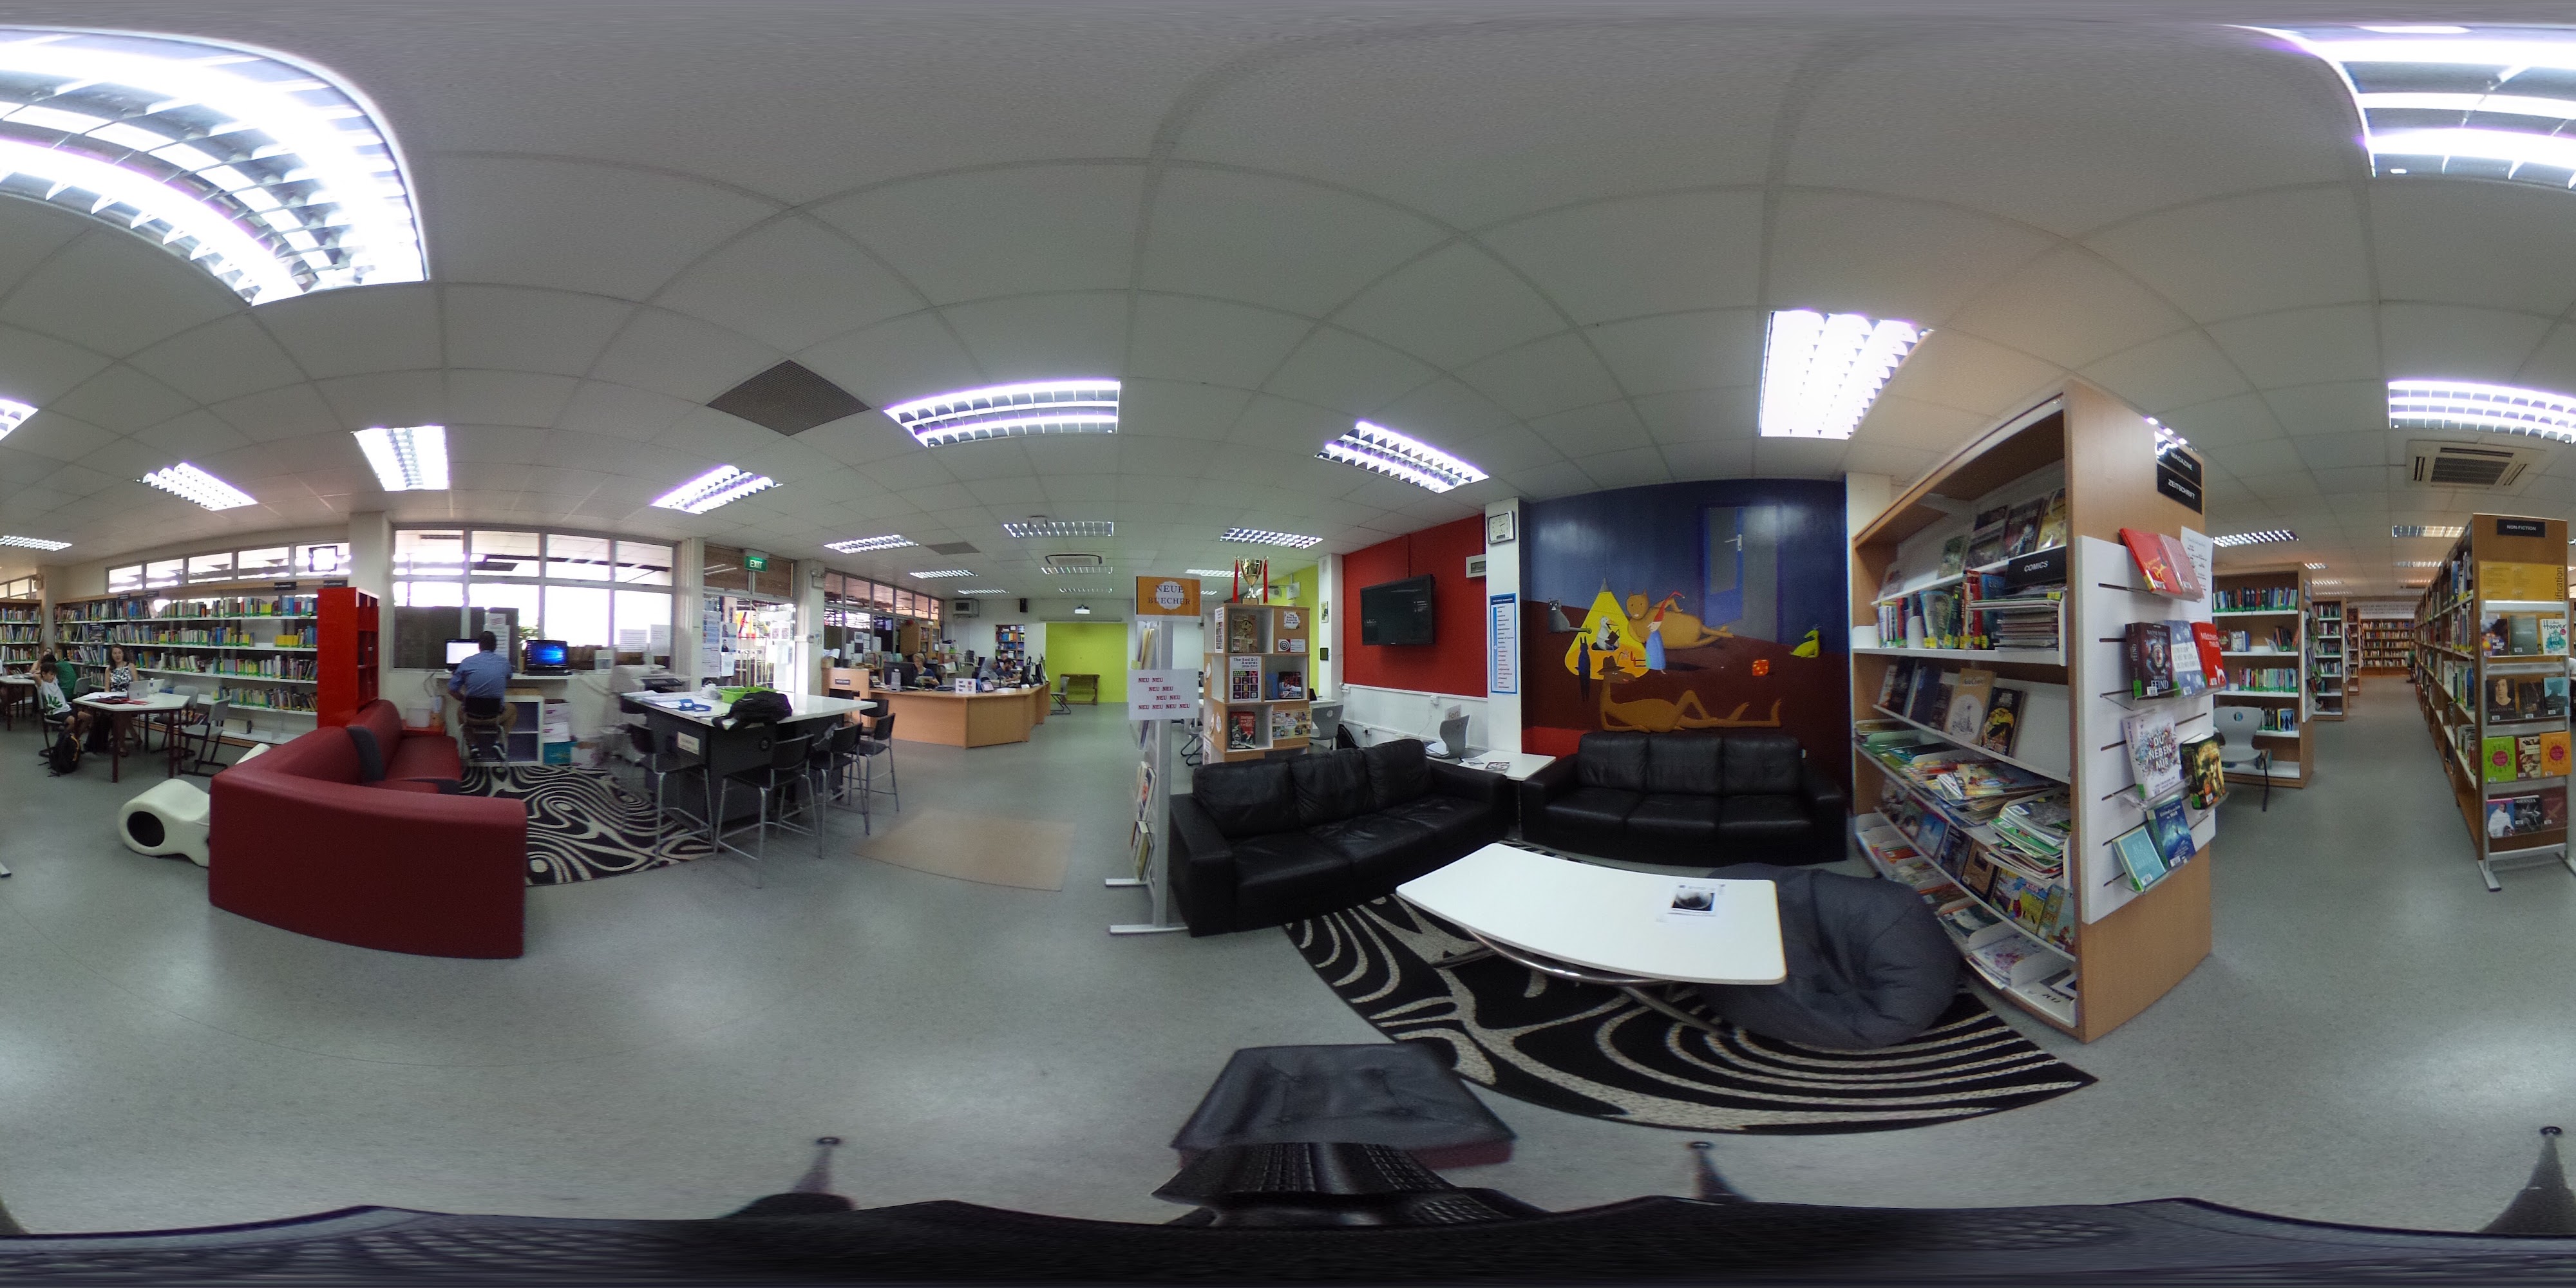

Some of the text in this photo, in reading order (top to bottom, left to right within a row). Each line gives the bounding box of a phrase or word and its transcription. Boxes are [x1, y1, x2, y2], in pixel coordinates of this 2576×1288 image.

[2170, 451, 2193, 471] MAGAZINE
[2168, 478, 2195, 499] ZEITSCHRIFT
[750, 559, 762, 569] EXIT
[2024, 560, 2049, 572] COMICS
[1155, 585, 1184, 593] NEUE
[1148, 597, 1191, 605] BUECHER
[2543, 620, 2566, 630] Hoover
[2154, 735, 2164, 746] DU
[2148, 744, 2172, 760] NEBEN
[2155, 757, 2169, 770] MIR
